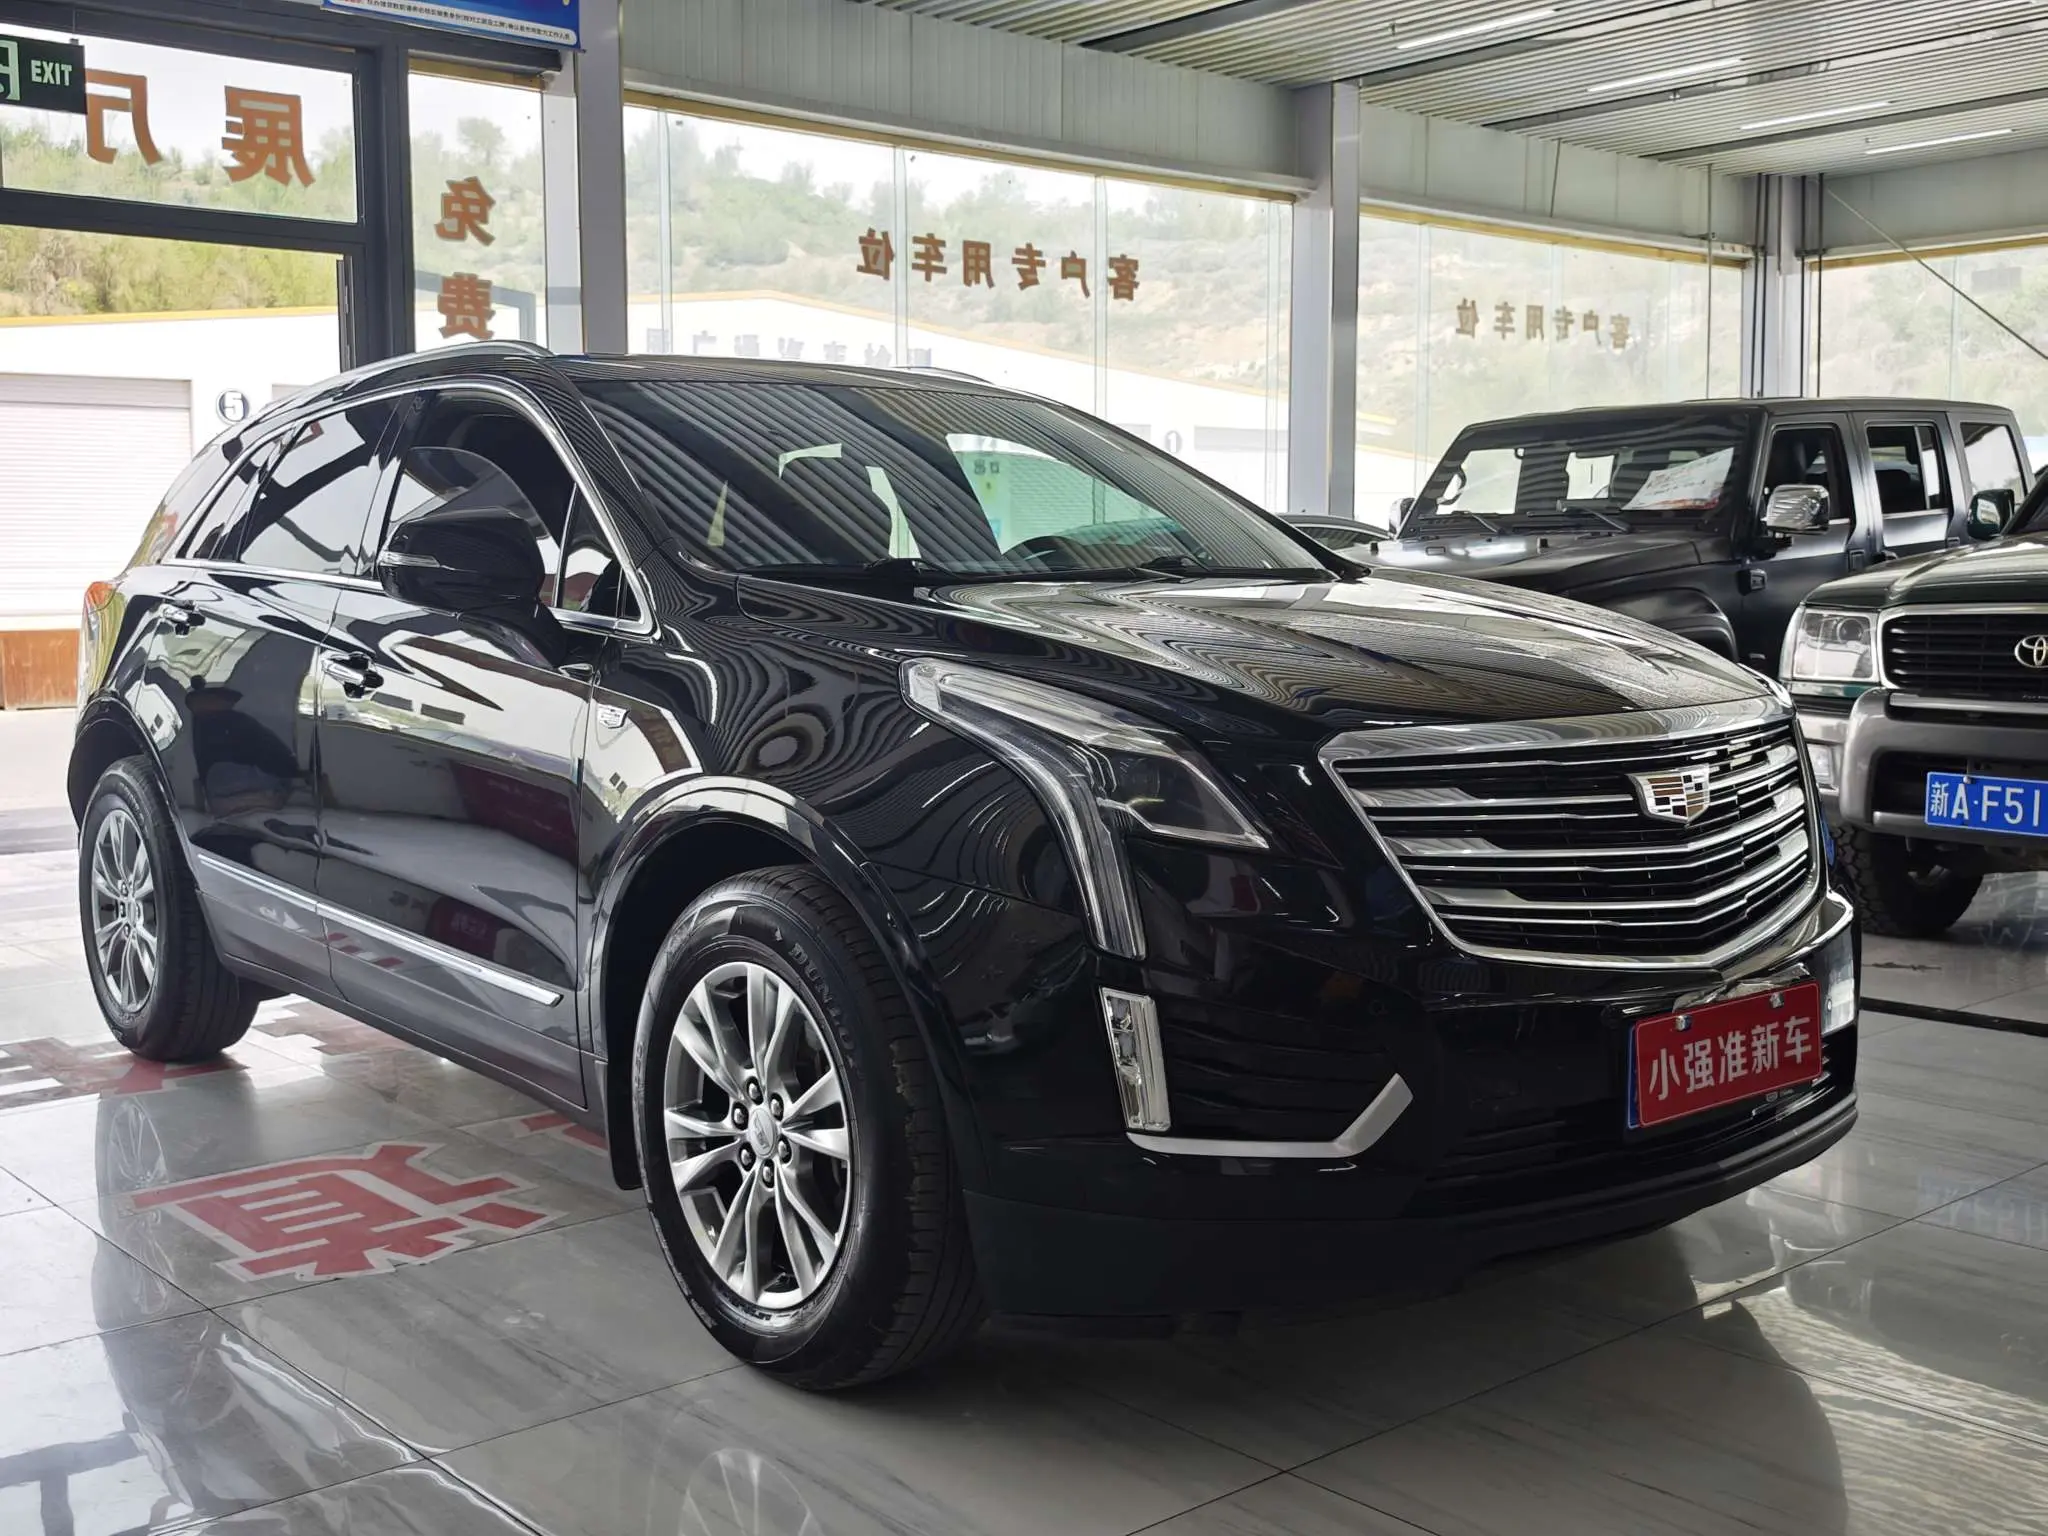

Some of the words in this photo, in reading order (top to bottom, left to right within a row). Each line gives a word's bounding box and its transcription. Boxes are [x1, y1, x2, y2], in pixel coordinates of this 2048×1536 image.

[30, 59, 72, 87] EXIT
[222, 390, 246, 422] 5
[1649, 1016, 1812, 1101] 小强准新车
